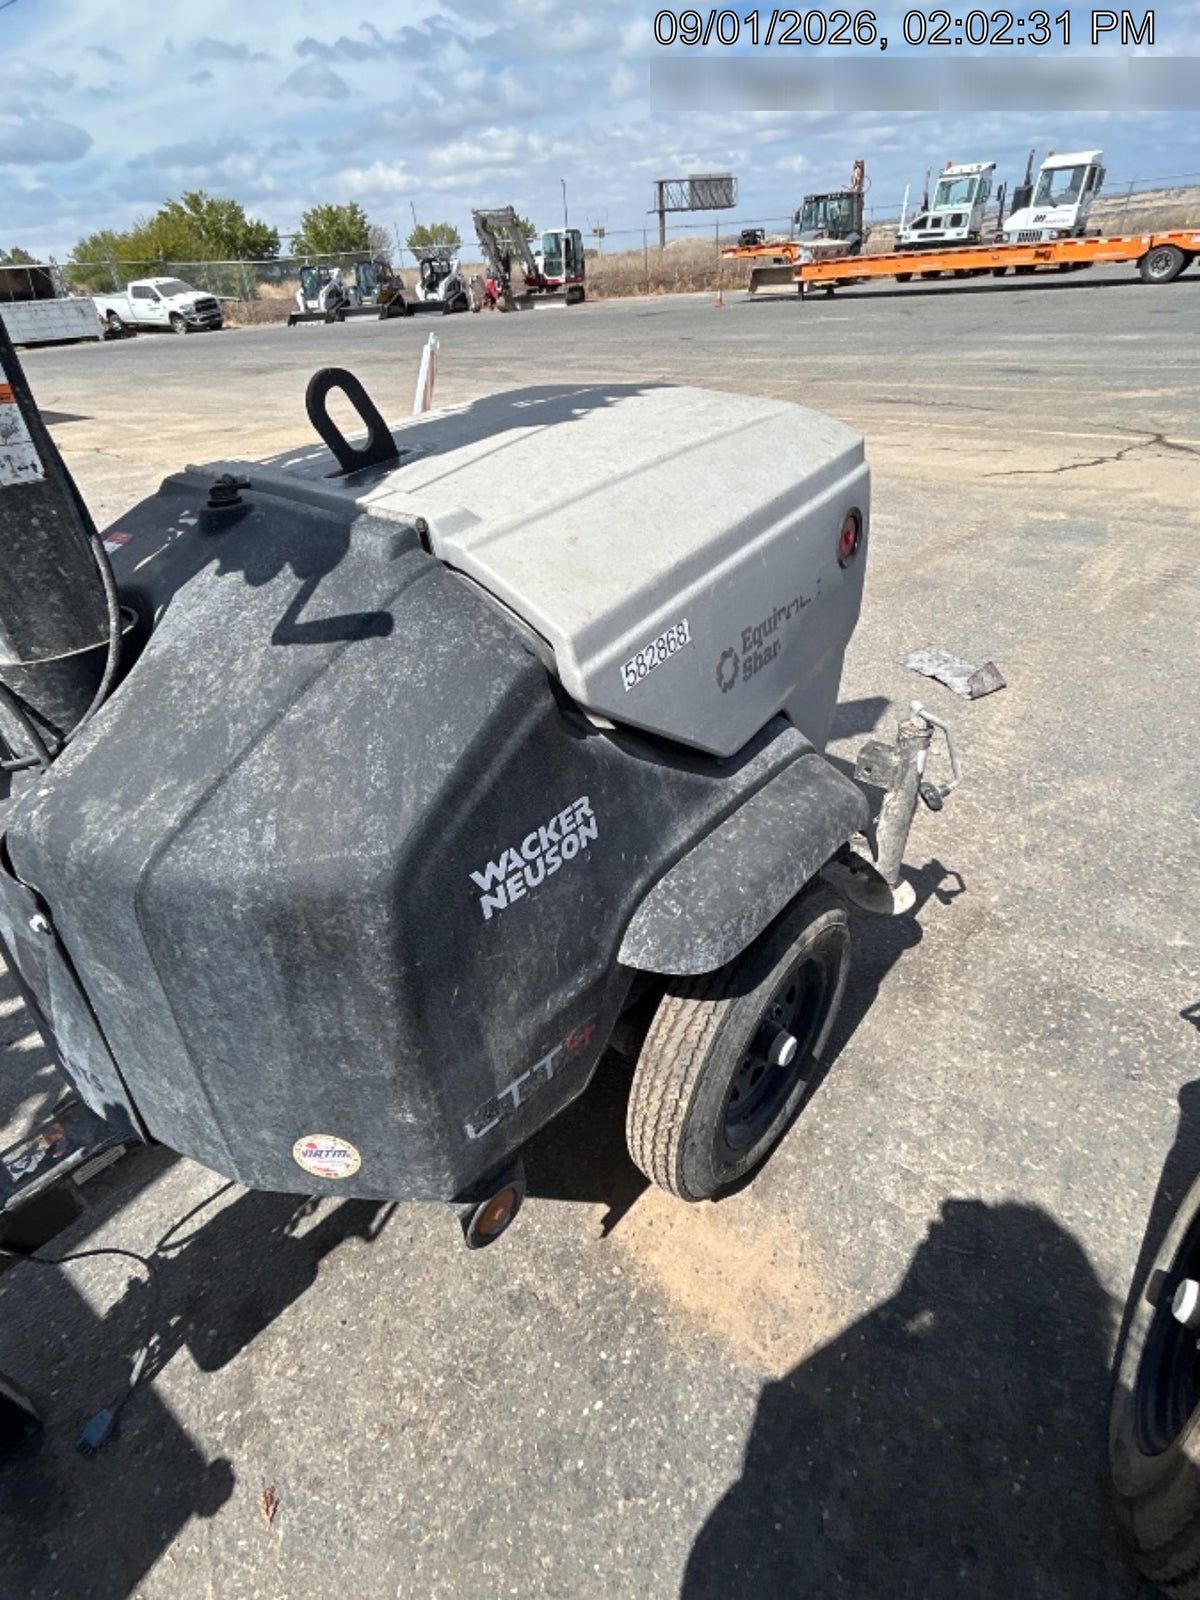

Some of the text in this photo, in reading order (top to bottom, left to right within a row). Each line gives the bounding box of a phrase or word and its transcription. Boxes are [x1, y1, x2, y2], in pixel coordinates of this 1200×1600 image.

[625, 623, 687, 687] 582868
[742, 639, 782, 683] Shar
[469, 795, 594, 891] WACKER
[479, 815, 599, 920] NEUSON
